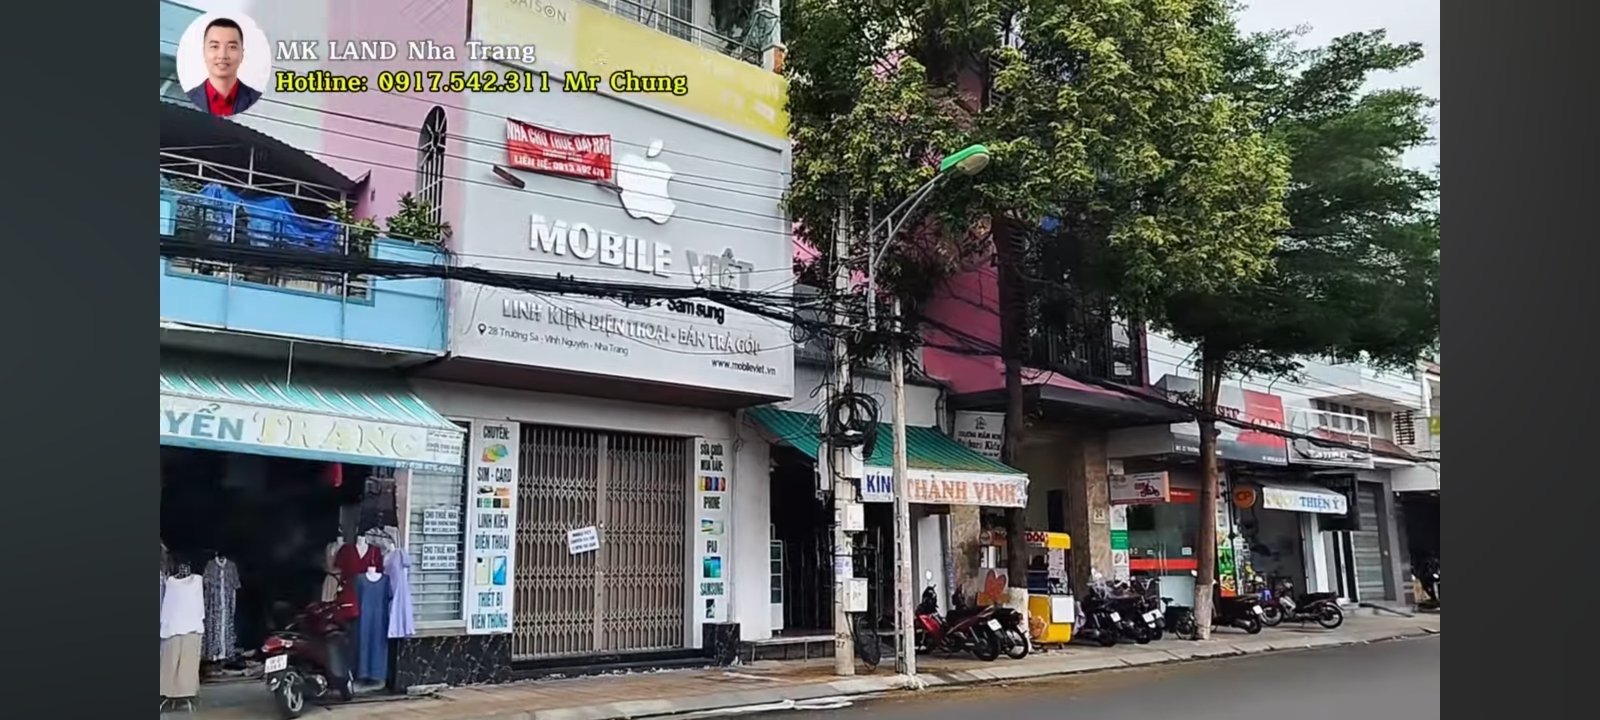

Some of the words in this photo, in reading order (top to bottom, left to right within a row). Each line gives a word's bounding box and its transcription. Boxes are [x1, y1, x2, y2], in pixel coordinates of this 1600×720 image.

[529, 212, 672, 278] MOBILE
[502, 297, 542, 323] LINH
[548, 304, 586, 331] KIỆN
[627, 319, 669, 345] THOẠI
[678, 324, 705, 348] BÁN
[708, 330, 733, 354] TRẢ
[487, 325, 499, 336] 28
[529, 333, 540, 343] Sa
[594, 342, 609, 352] Nha
[610, 344, 630, 357] Trang
[711, 358, 777, 376] www.mobileviet.vn
[477, 466, 490, 482] SIM
[495, 467, 512, 483] CARD
[477, 512, 493, 529] LINH
[491, 534, 510, 553] THOẠI
[700, 581, 724, 597] SAMSUNG
